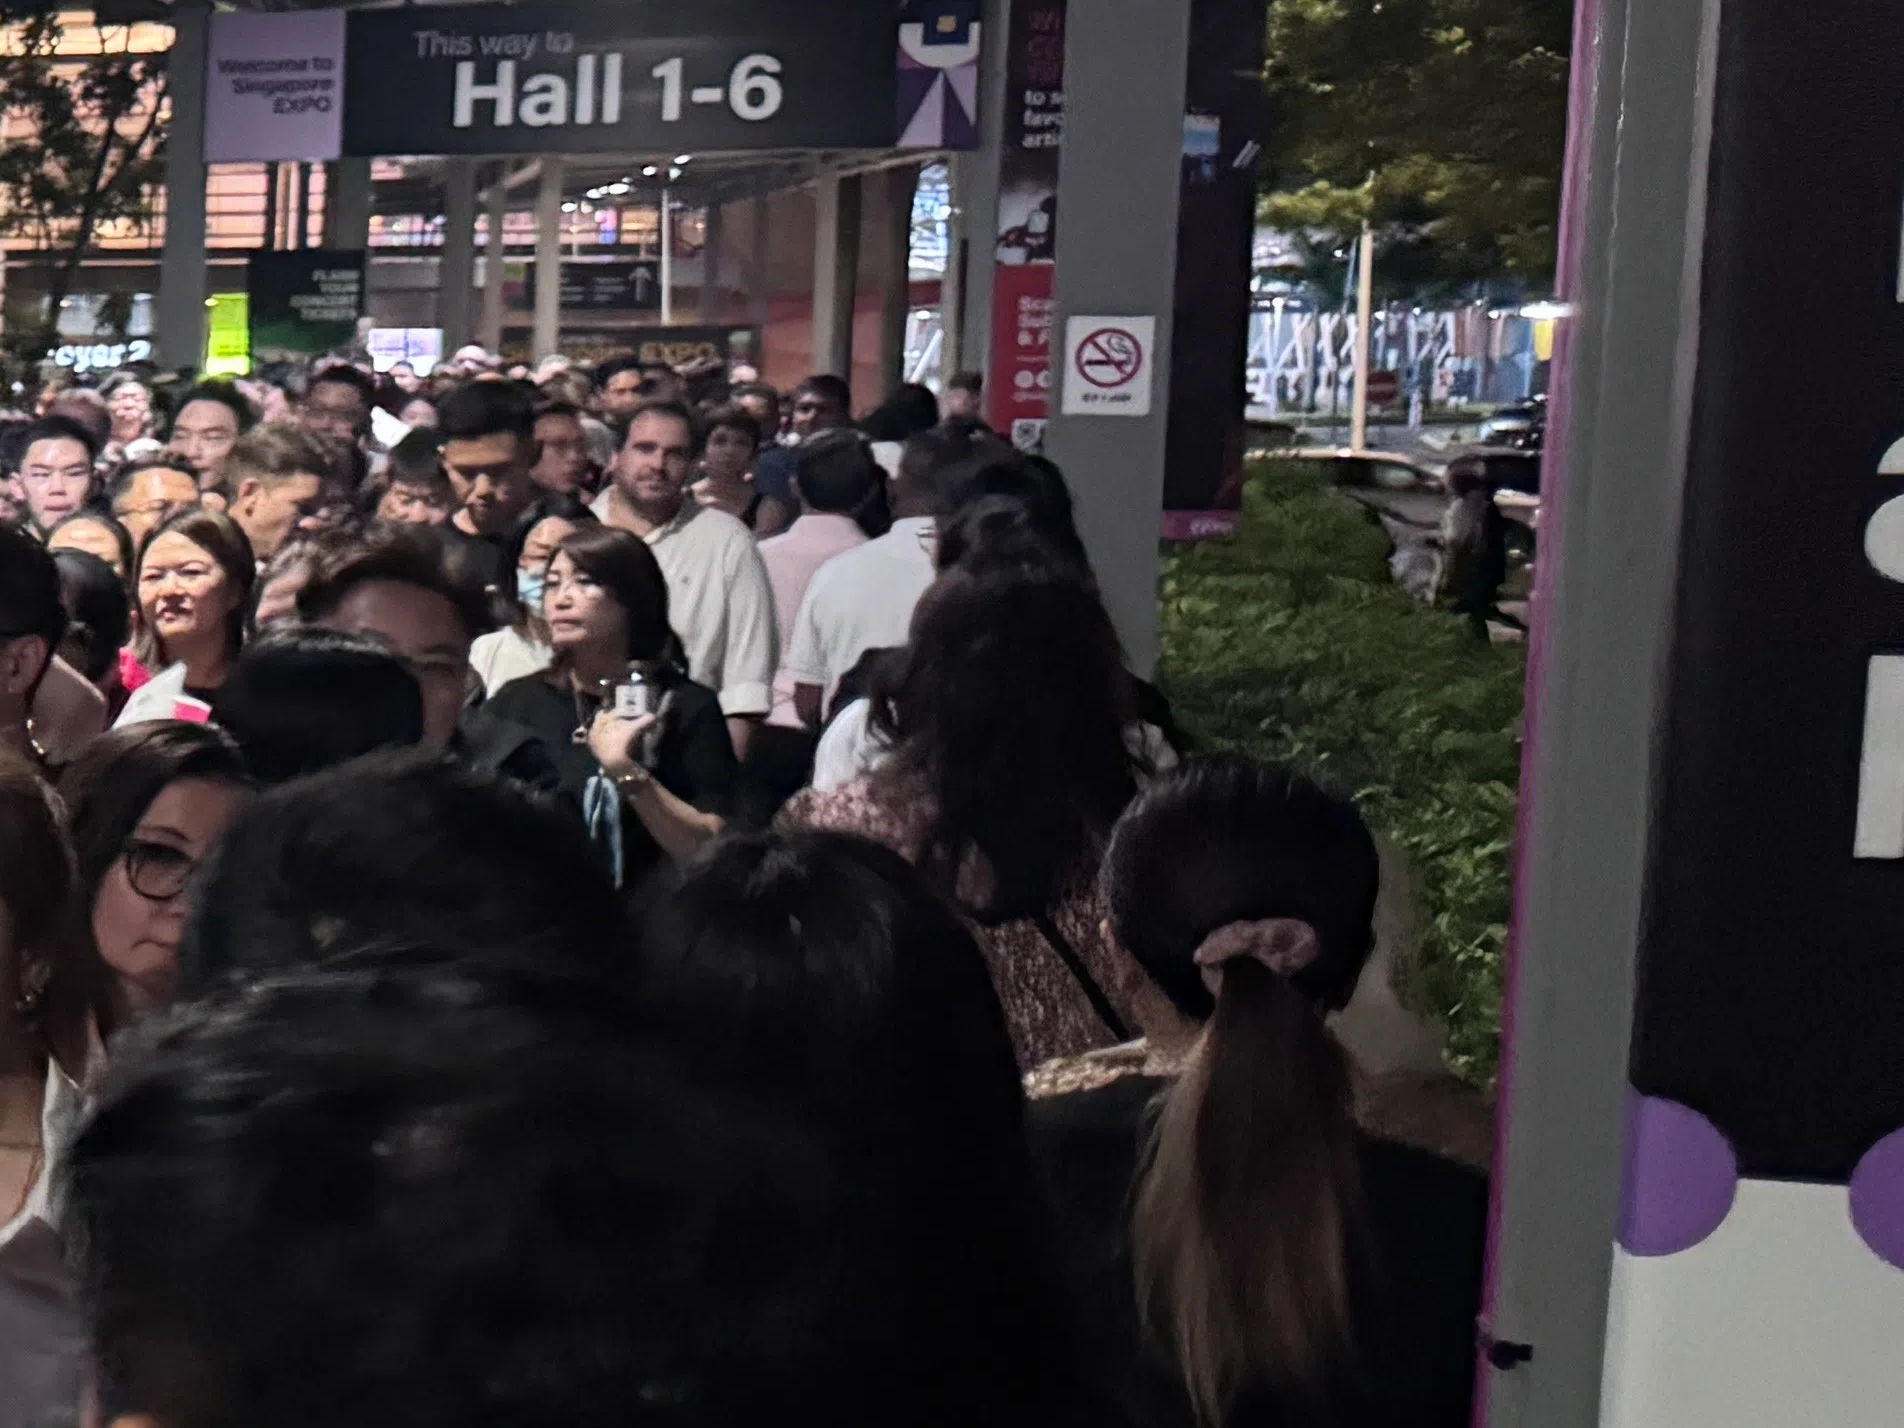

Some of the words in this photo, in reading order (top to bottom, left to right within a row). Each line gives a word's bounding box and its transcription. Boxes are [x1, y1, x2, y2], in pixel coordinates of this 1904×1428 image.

[413, 29, 473, 58] This
[475, 32, 538, 61] way
[546, 30, 574, 54] to
[217, 58, 309, 75] Welcome
[231, 78, 335, 98] Singapore
[452, 52, 624, 128] Hall
[651, 52, 784, 123] 1-6
[272, 95, 333, 114] EXPO
